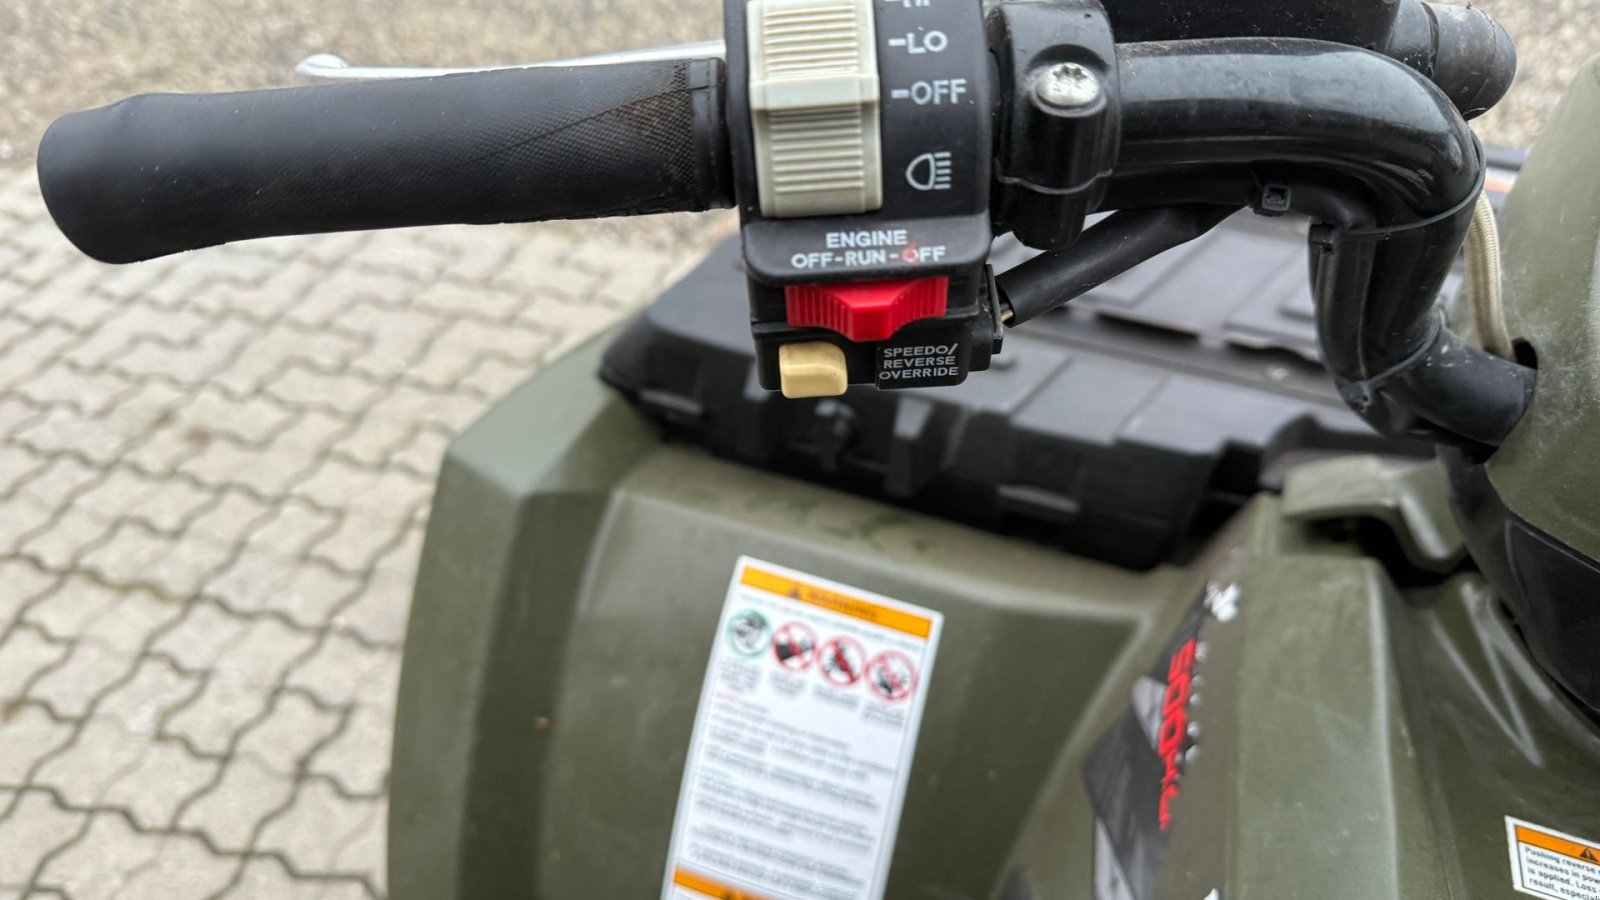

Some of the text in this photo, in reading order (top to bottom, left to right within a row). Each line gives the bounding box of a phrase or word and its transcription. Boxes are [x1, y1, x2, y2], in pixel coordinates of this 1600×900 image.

[826, 229, 908, 249] ENGINE
[883, 343, 958, 358] SPEEDO/
[883, 355, 956, 369] REVERSE
[879, 366, 959, 380] OVERRIDE
[1525, 847, 1560, 863] Pushing
[1562, 859, 1596, 873] reverse
[1526, 858, 1570, 875] increases
[1571, 870, 1580, 879] in
[1528, 867, 1535, 875] is
[1576, 880, 1597, 893] Loss
[1530, 878, 1558, 893] result,
